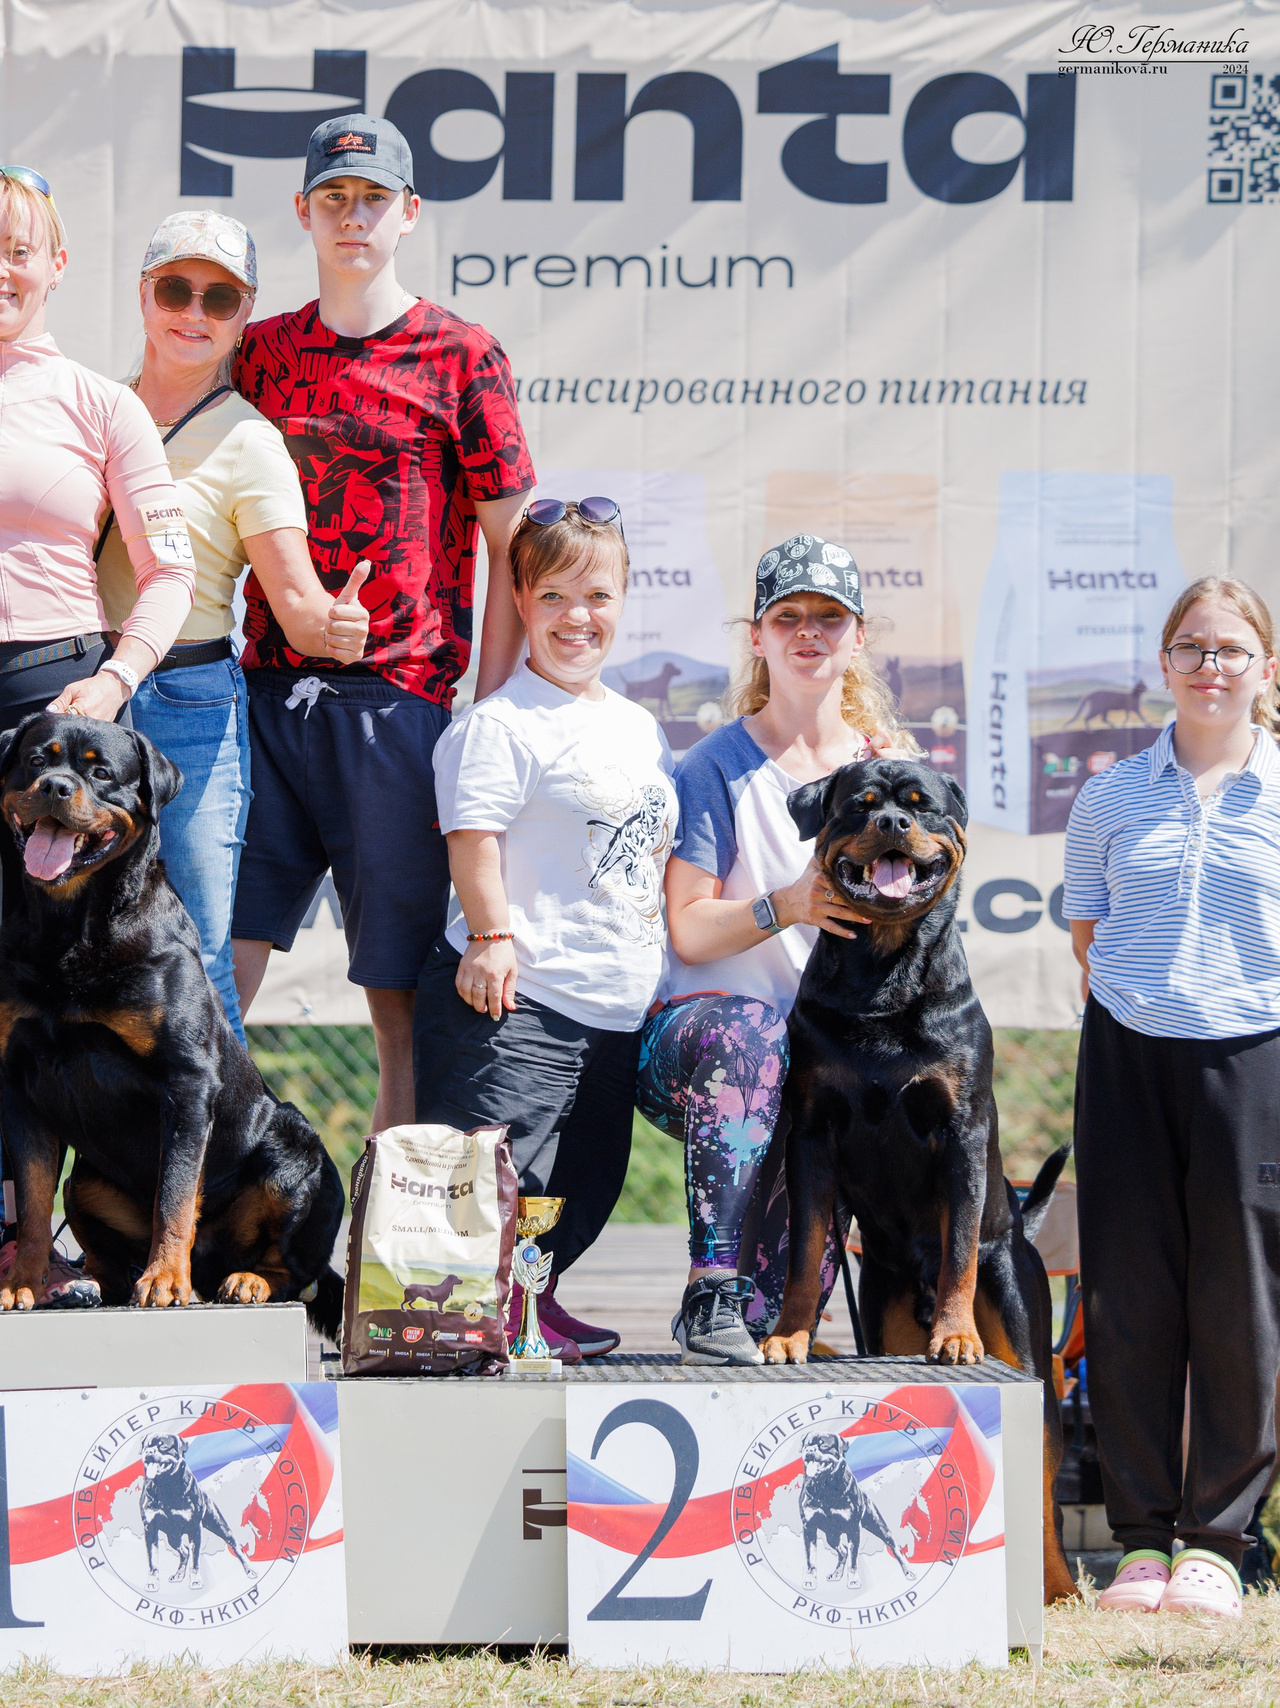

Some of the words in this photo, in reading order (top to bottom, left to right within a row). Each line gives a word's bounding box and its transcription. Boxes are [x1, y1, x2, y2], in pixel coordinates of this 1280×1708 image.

[180, 43, 1077, 204] Hanta
[451, 244, 794, 297] premium
[297, 351, 404, 392] JUMPMAN
[878, 376, 1089, 406] питания
[785, 535, 812, 549] NETS
[1048, 568, 1158, 591] Hanta
[989, 671, 1009, 811] Hanta
[391, 1172, 474, 1200] Hanta
[412, 1200, 452, 1209] premium
[392, 1224, 469, 1238] SMALL/MEDIUM
[75, 1404, 162, 1571] РОТВЕЙЛЕР
[179, 1399, 259, 1436] КЛУБ
[265, 1438, 308, 1565] РОССИИ
[734, 1404, 822, 1567] РОТВЕЙЛЕР
[840, 1398, 920, 1437] КЛУБ
[926, 1441, 967, 1568] РОССИИ
[587, 1398, 714, 1621] 2
[135, 1586, 262, 1627] РКФ-НКПР
[792, 1590, 920, 1626] РКФ-НКПР
